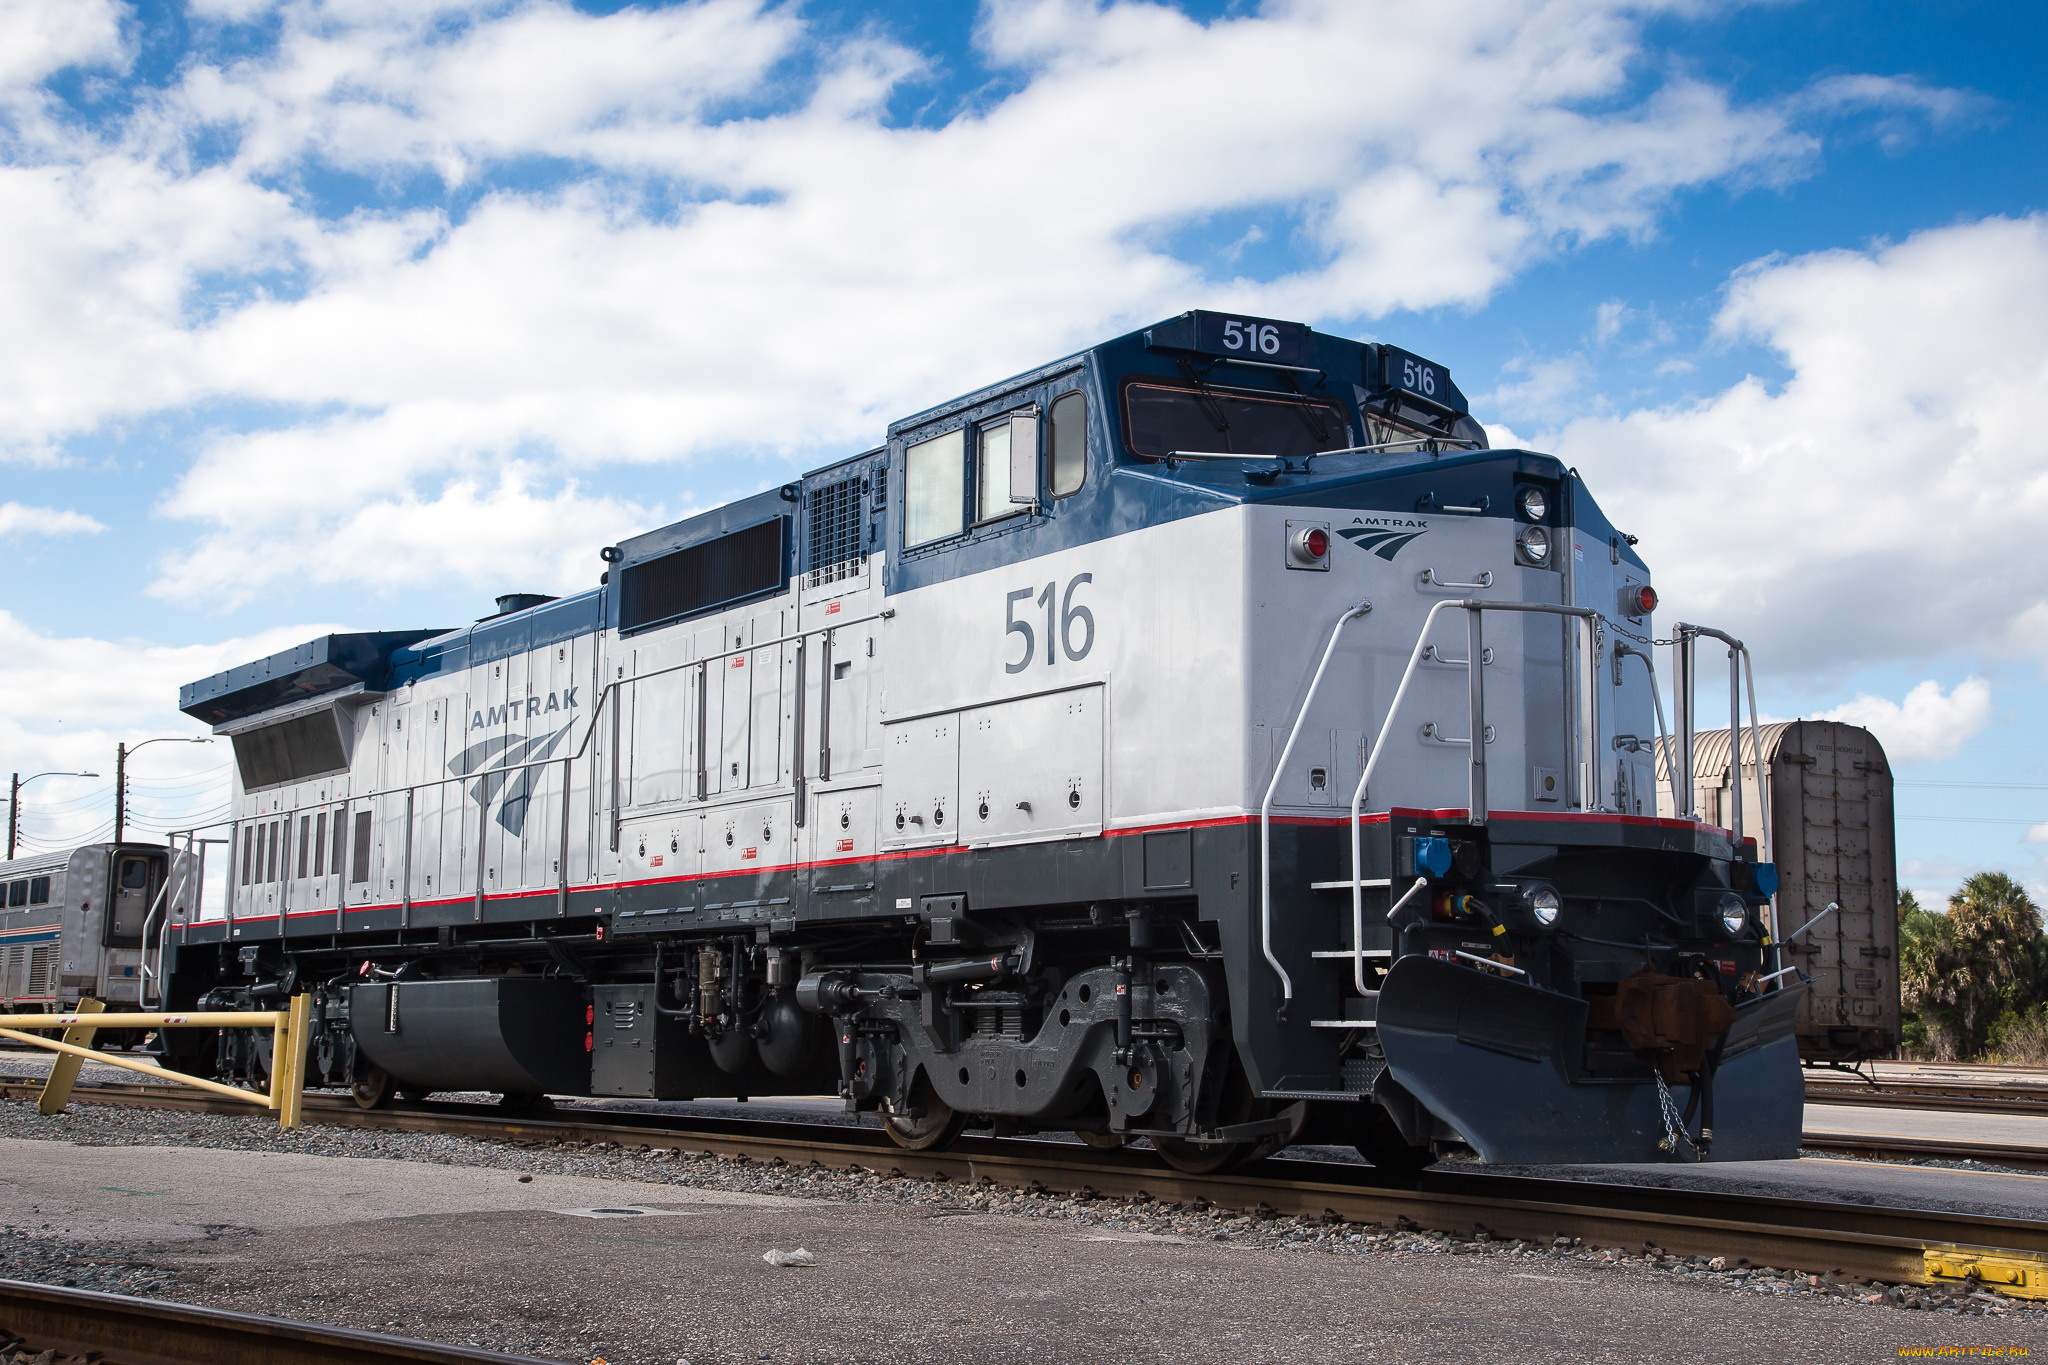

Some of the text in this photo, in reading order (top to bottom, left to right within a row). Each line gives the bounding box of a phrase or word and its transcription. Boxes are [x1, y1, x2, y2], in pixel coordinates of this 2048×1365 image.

[1223, 320, 1280, 355] 516
[1403, 359, 1435, 395] 516
[1352, 517, 1429, 528] AMTRAK
[1006, 573, 1095, 674] 516
[470, 686, 579, 731] AMTRAK
